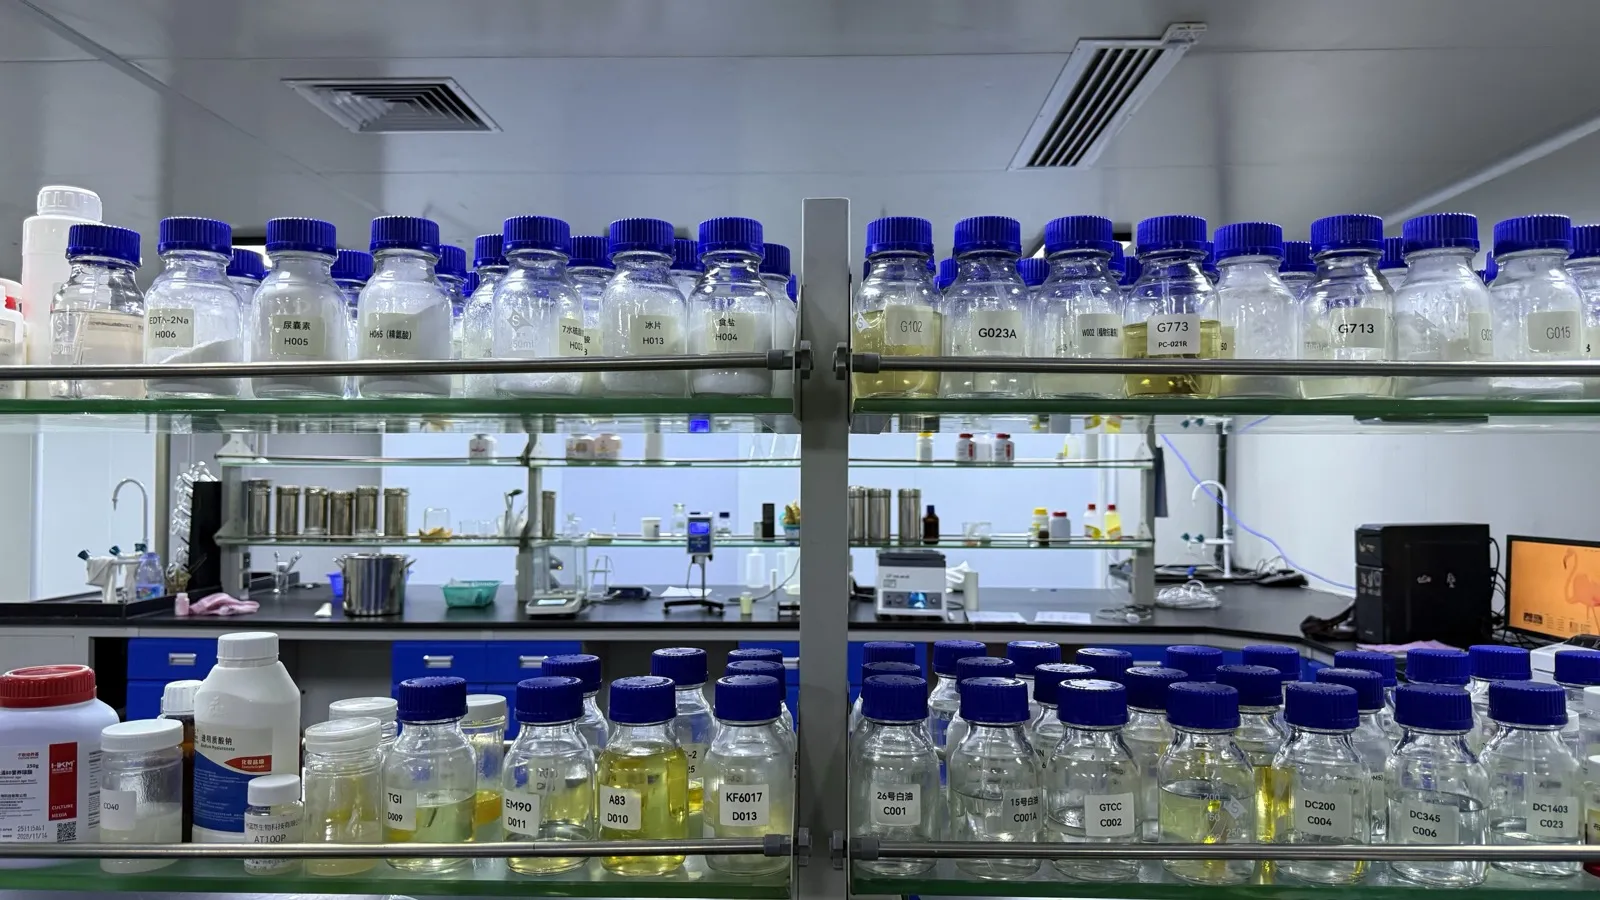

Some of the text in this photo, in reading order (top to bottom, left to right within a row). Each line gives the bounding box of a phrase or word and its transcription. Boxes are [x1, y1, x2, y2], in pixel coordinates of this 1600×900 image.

[149, 316, 189, 325] EDTA-2Na
[283, 320, 311, 331] 尿囊素
[645, 321, 662, 330] 冰片
[719, 317, 736, 327] 食盐
[900, 320, 923, 333] G102
[1157, 321, 1189, 333] G773
[1338, 323, 1375, 334] G713
[155, 330, 177, 339] H006
[715, 333, 738, 341] H004
[978, 327, 1017, 339] G023A
[1546, 326, 1571, 340] G015
[284, 337, 309, 346] H005
[642, 337, 664, 345] H013
[609, 795, 625, 805] A83
[726, 792, 763, 803] KF6017
[877, 791, 914, 801] 26号白油
[1010, 796, 1039, 806] 15号白油
[505, 798, 532, 812] EM90
[1099, 803, 1122, 812] GTCC
[1304, 800, 1336, 811] DC200
[1532, 803, 1568, 814] DC1403
[883, 806, 906, 815] C001
[388, 811, 403, 822] D009
[607, 813, 629, 824] D010
[732, 812, 757, 821] D013
[1013, 812, 1037, 822] C001A
[1307, 816, 1332, 826] C004
[1409, 810, 1441, 823] DC345
[507, 817, 526, 829] D011
[1100, 818, 1122, 827] C002
[1540, 819, 1563, 829] C023
[1412, 826, 1437, 838] C006
[254, 834, 287, 844] AT100P
